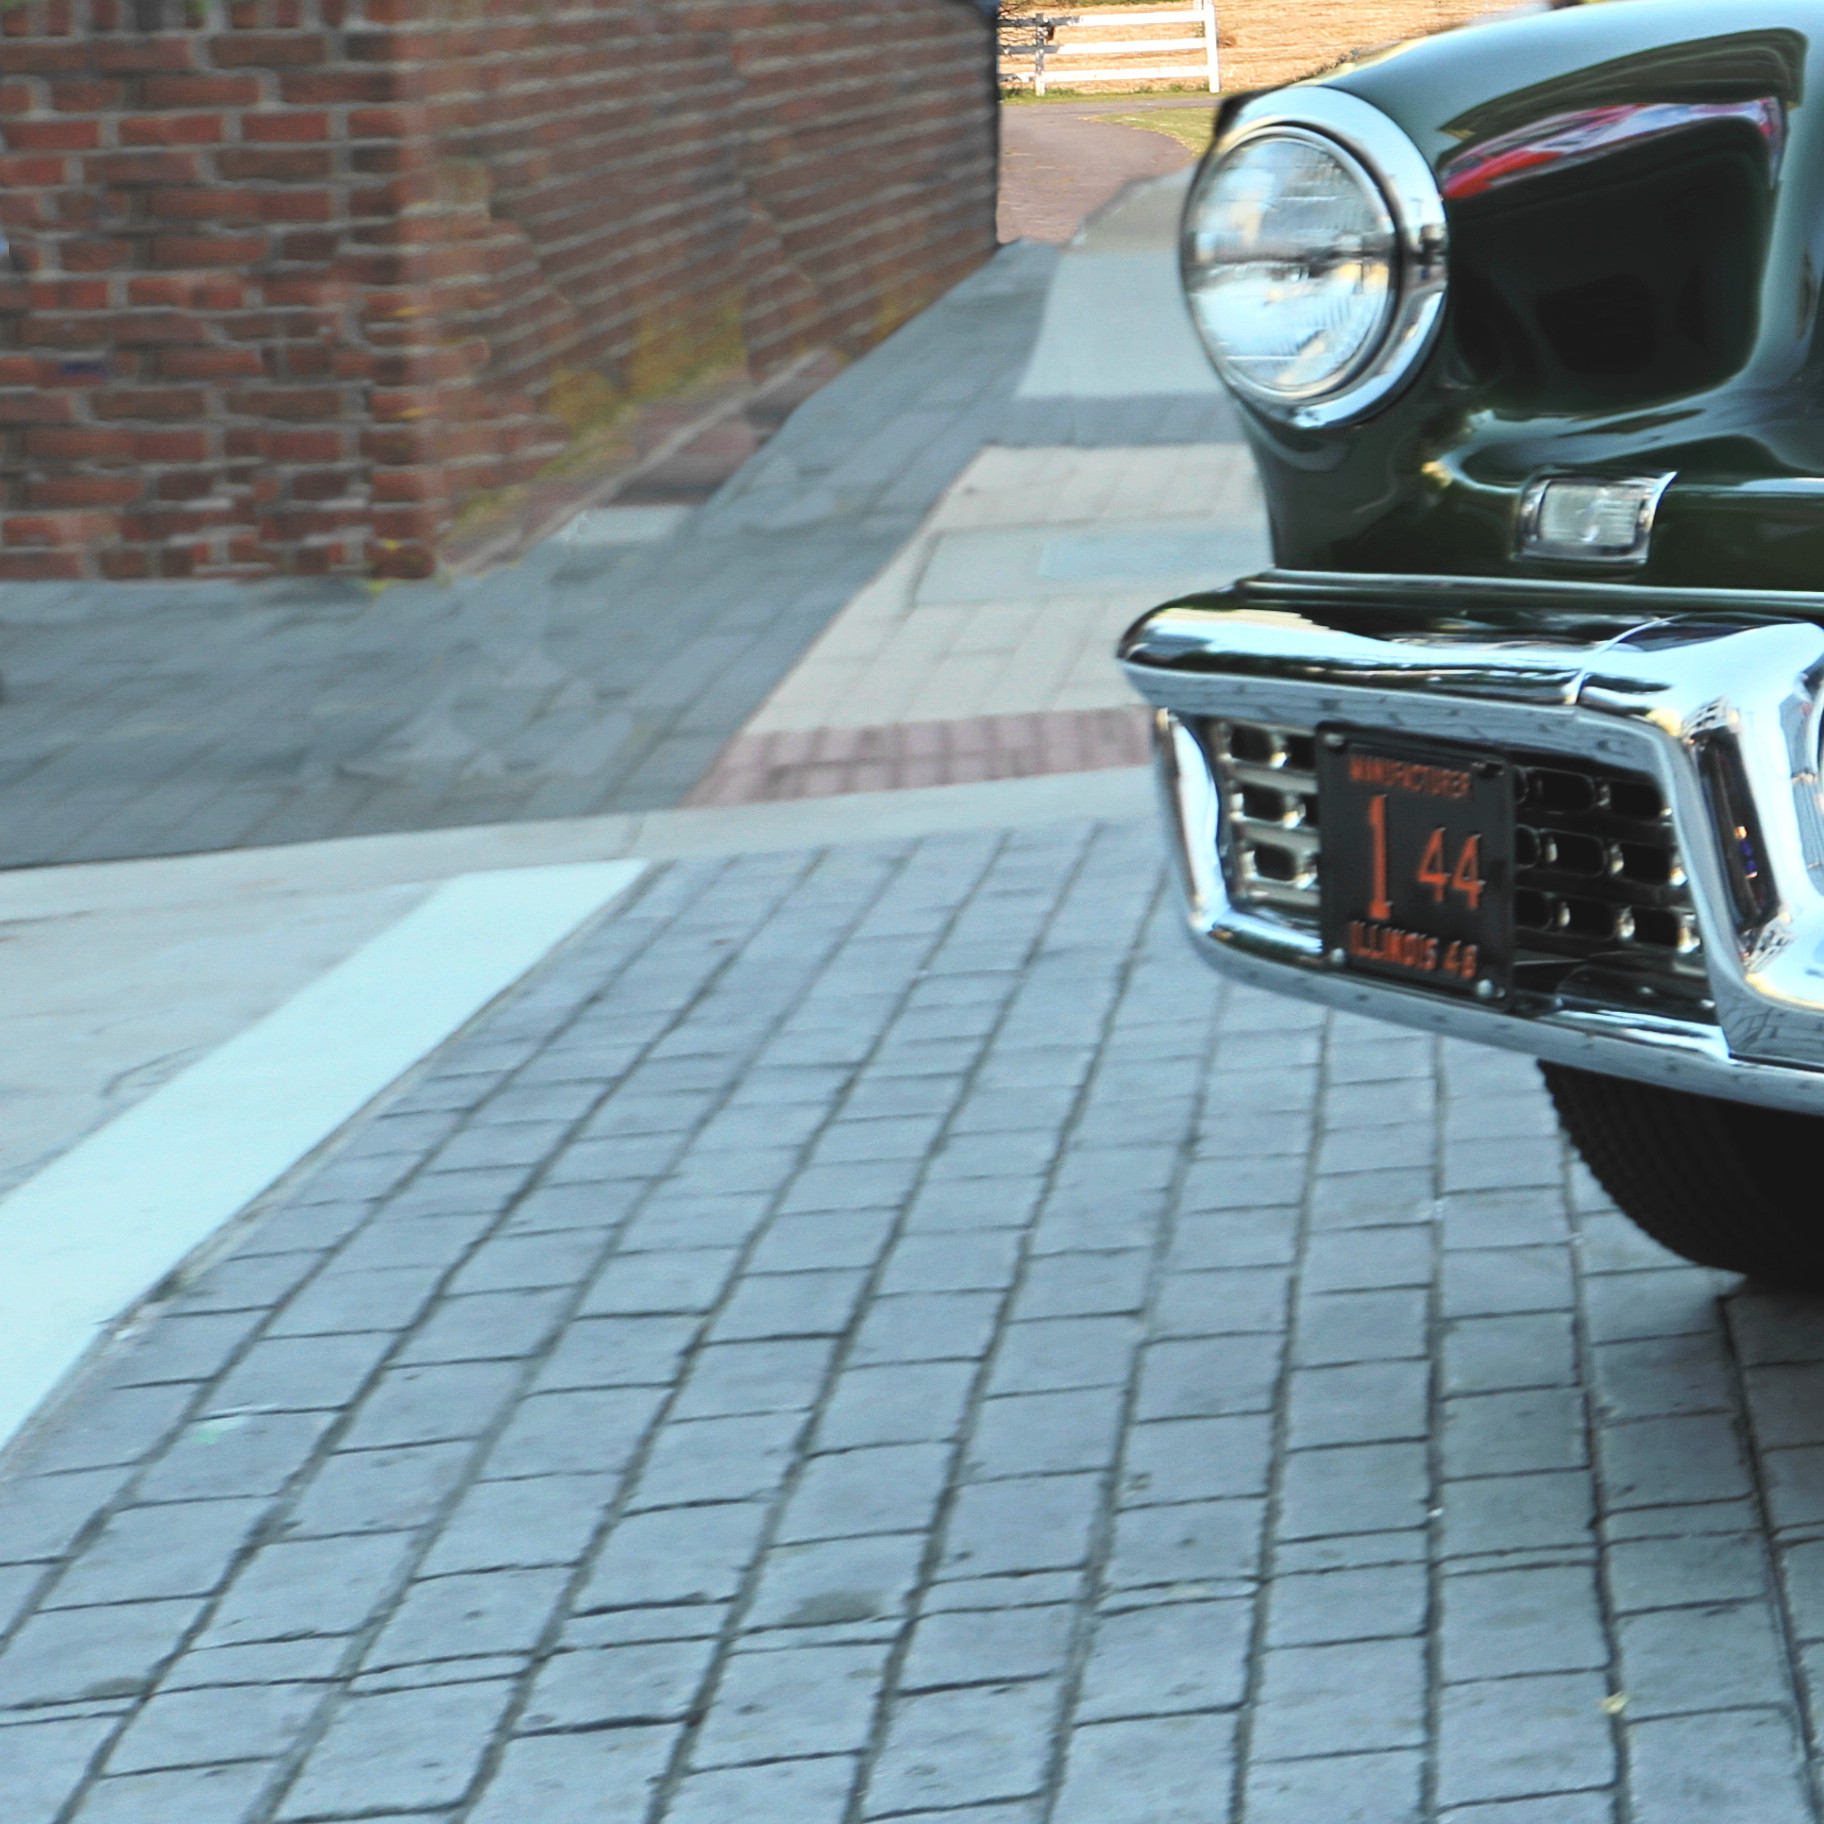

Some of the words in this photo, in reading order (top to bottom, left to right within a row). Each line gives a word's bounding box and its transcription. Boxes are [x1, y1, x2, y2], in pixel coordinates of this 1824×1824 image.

[1369, 794, 1393, 919] 1
[1418, 827, 1485, 909] 44
[1350, 921, 1438, 971] ILLINOIS
